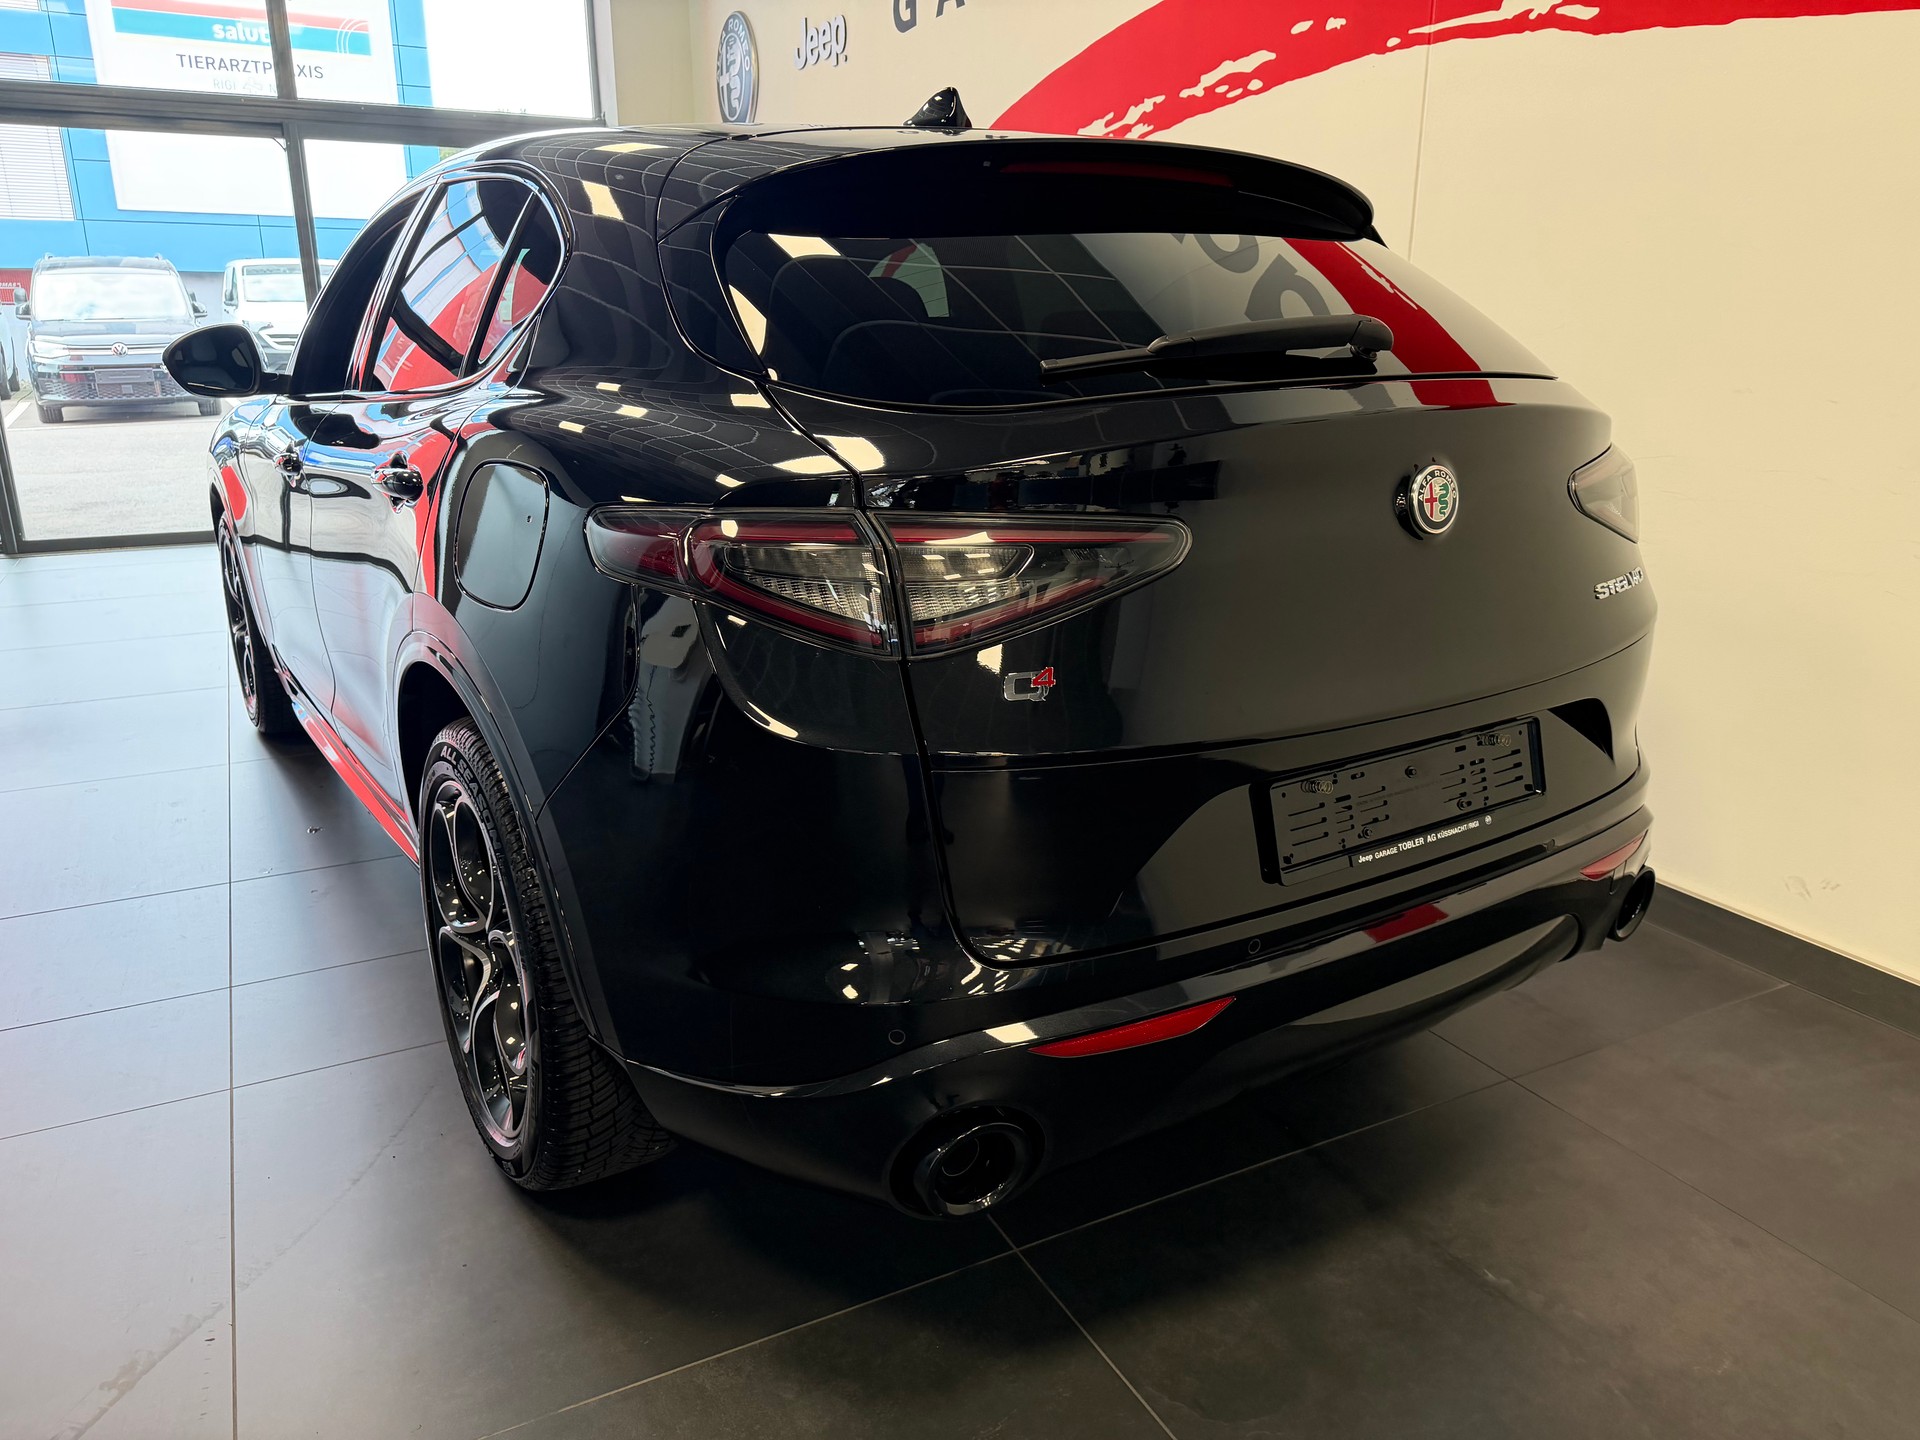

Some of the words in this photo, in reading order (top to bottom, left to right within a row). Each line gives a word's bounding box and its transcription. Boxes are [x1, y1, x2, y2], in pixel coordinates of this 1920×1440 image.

[212, 23, 271, 44] salut
[794, 14, 847, 70] Jeep
[176, 53, 324, 79] TIERARZTPXIS
[213, 78, 237, 91] RIGI
[1418, 474, 1432, 502] ALFA
[1434, 470, 1457, 499] ROMEO
[1003, 666, 1057, 702] Q4
[441, 745, 457, 765] ALL
[458, 759, 501, 850] SEASON
[1358, 855, 1373, 863] Jeep
[1374, 846, 1398, 859] GARAGE
[1398, 837, 1425, 852] TOBLER
[1427, 833, 1437, 843] AG
